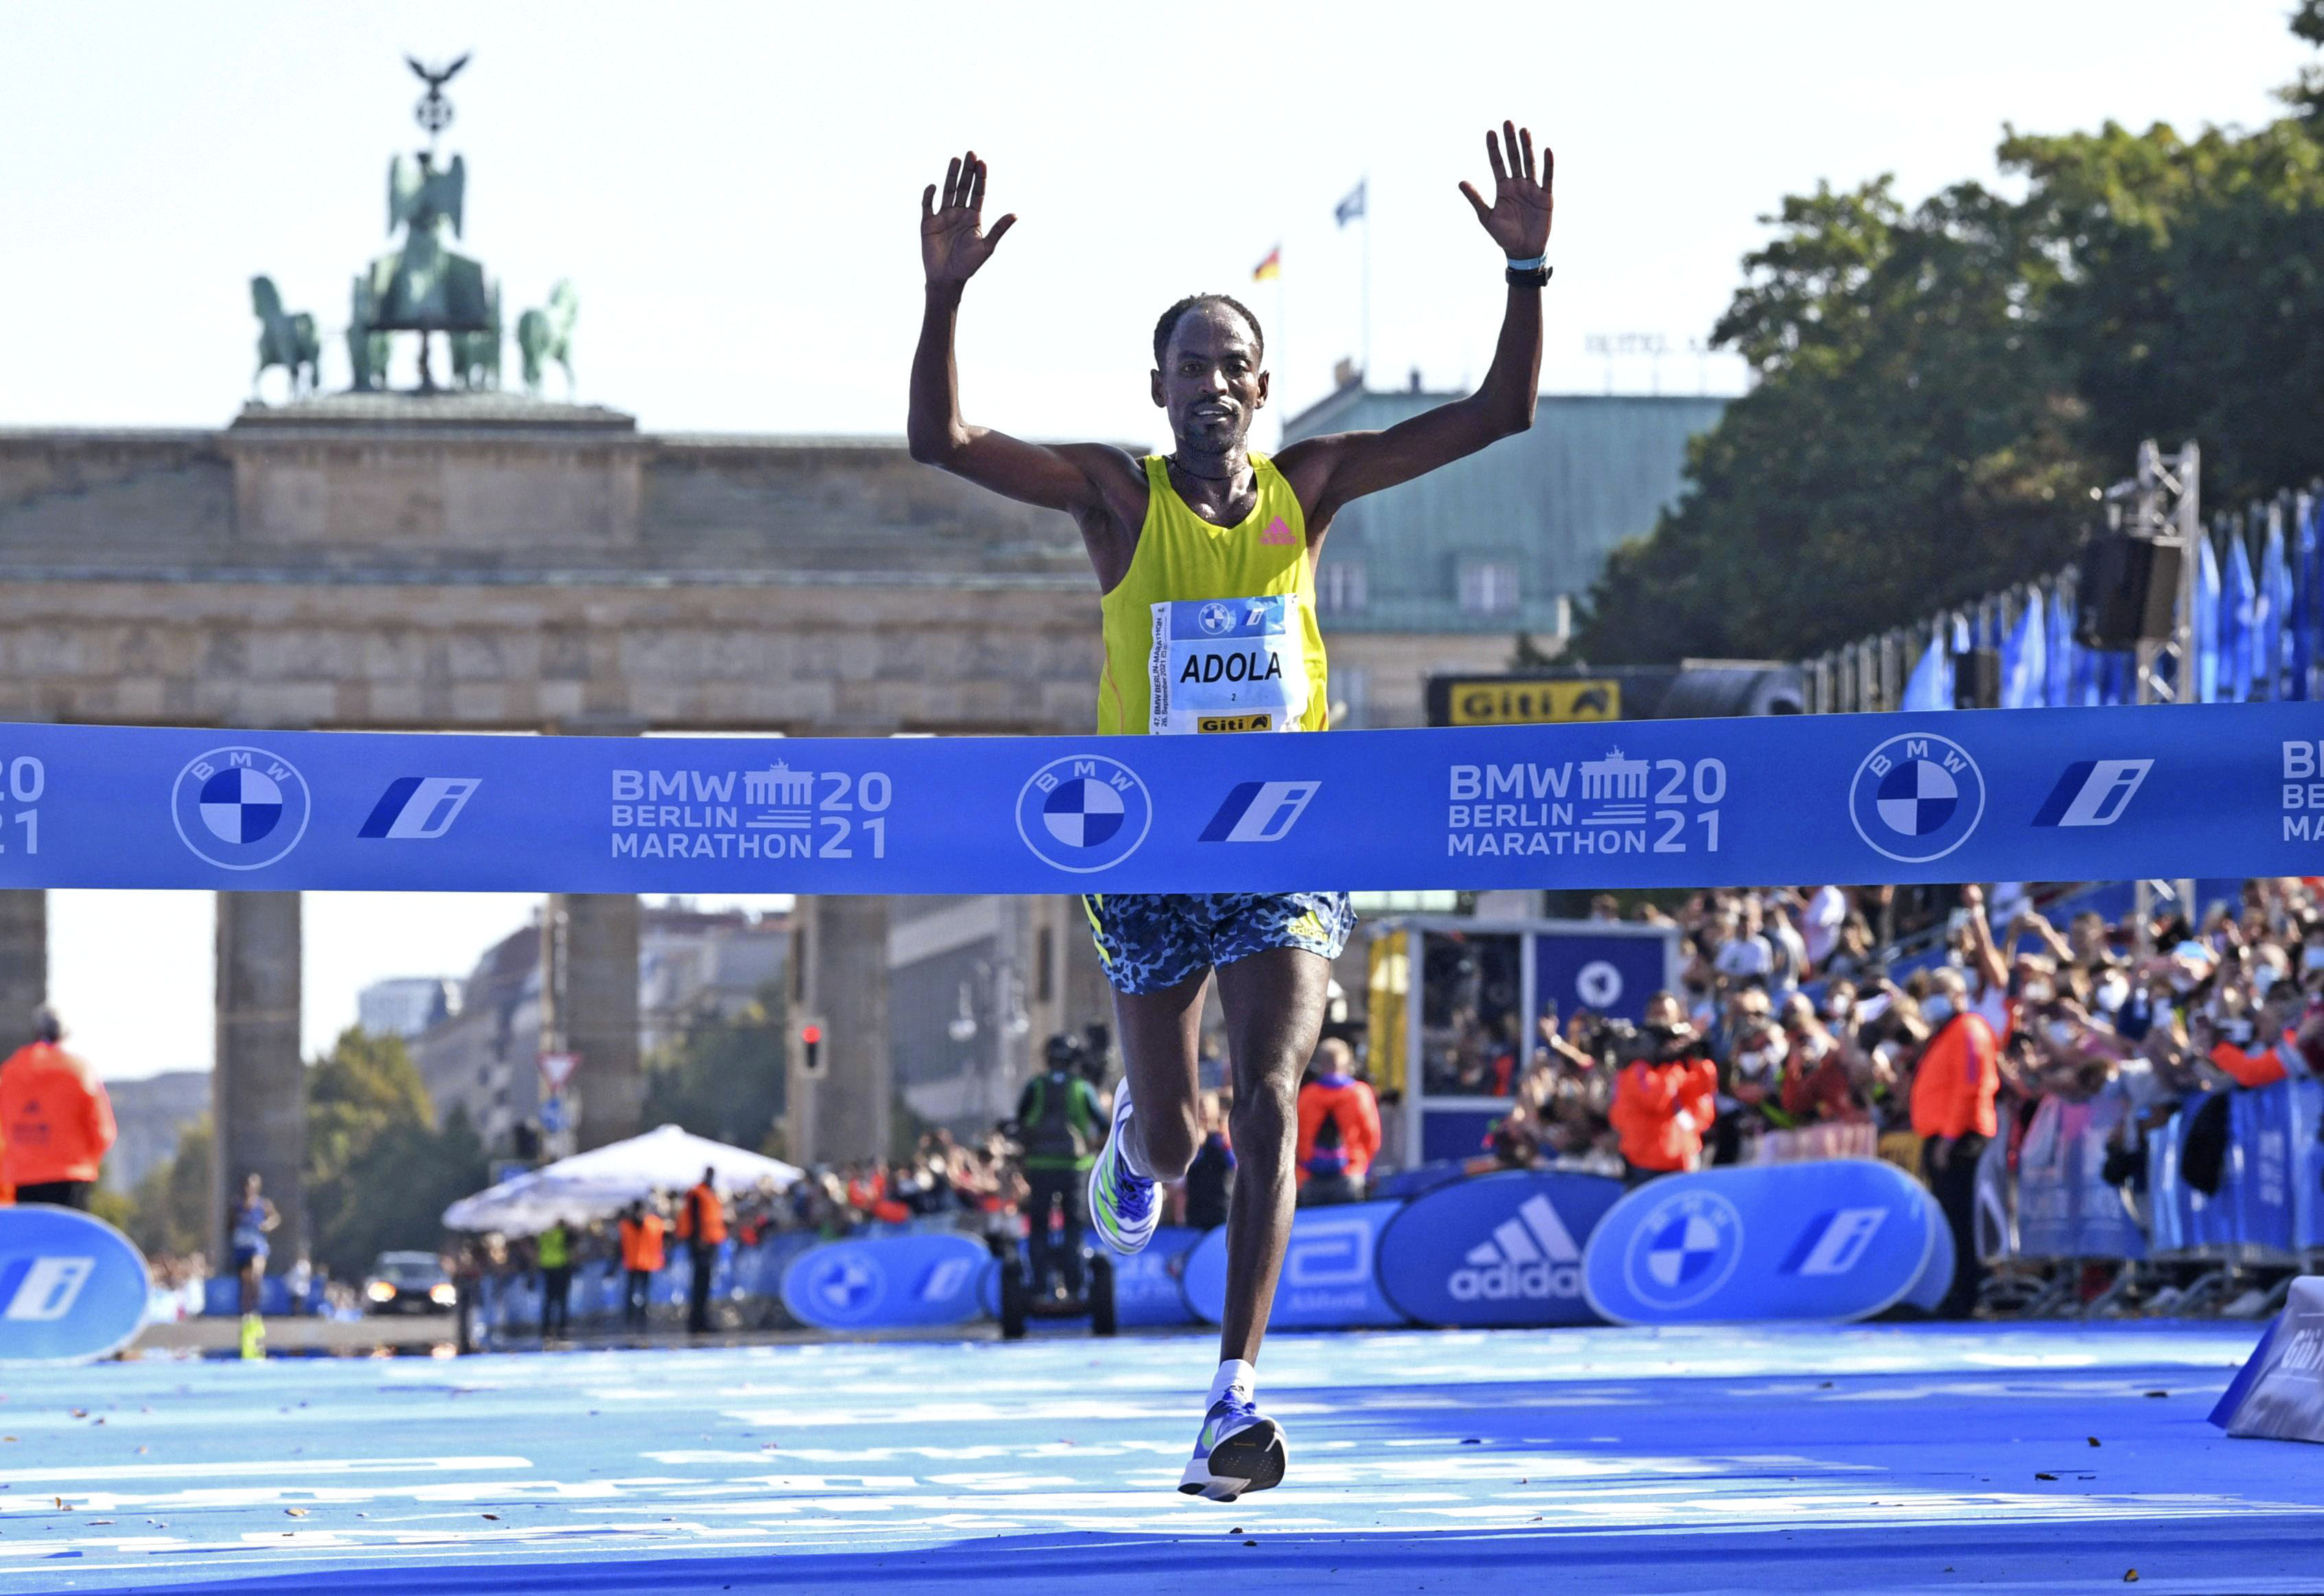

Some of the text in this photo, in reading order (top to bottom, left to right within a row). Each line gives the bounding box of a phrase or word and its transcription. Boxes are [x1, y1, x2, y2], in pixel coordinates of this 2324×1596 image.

[1180, 651, 1282, 683] ADOLA
[1231, 693, 1237, 702] 2
[1463, 691, 1551, 718] Giti
[1202, 719, 1244, 731] Giti
[191, 752, 291, 782] BMW
[1868, 740, 1967, 777] BMW
[0, 756, 45, 802] 0
[612, 770, 736, 802] BMW
[1036, 761, 1134, 794] BMW
[1450, 762, 1573, 800] BMW
[612, 805, 738, 828] BERLIN
[1449, 803, 1573, 828] BERLIN
[0, 809, 37, 854] 1
[612, 833, 811, 858] MARATHON
[1448, 829, 1646, 856] MARATHON
[1448, 1261, 1582, 1299] adida
